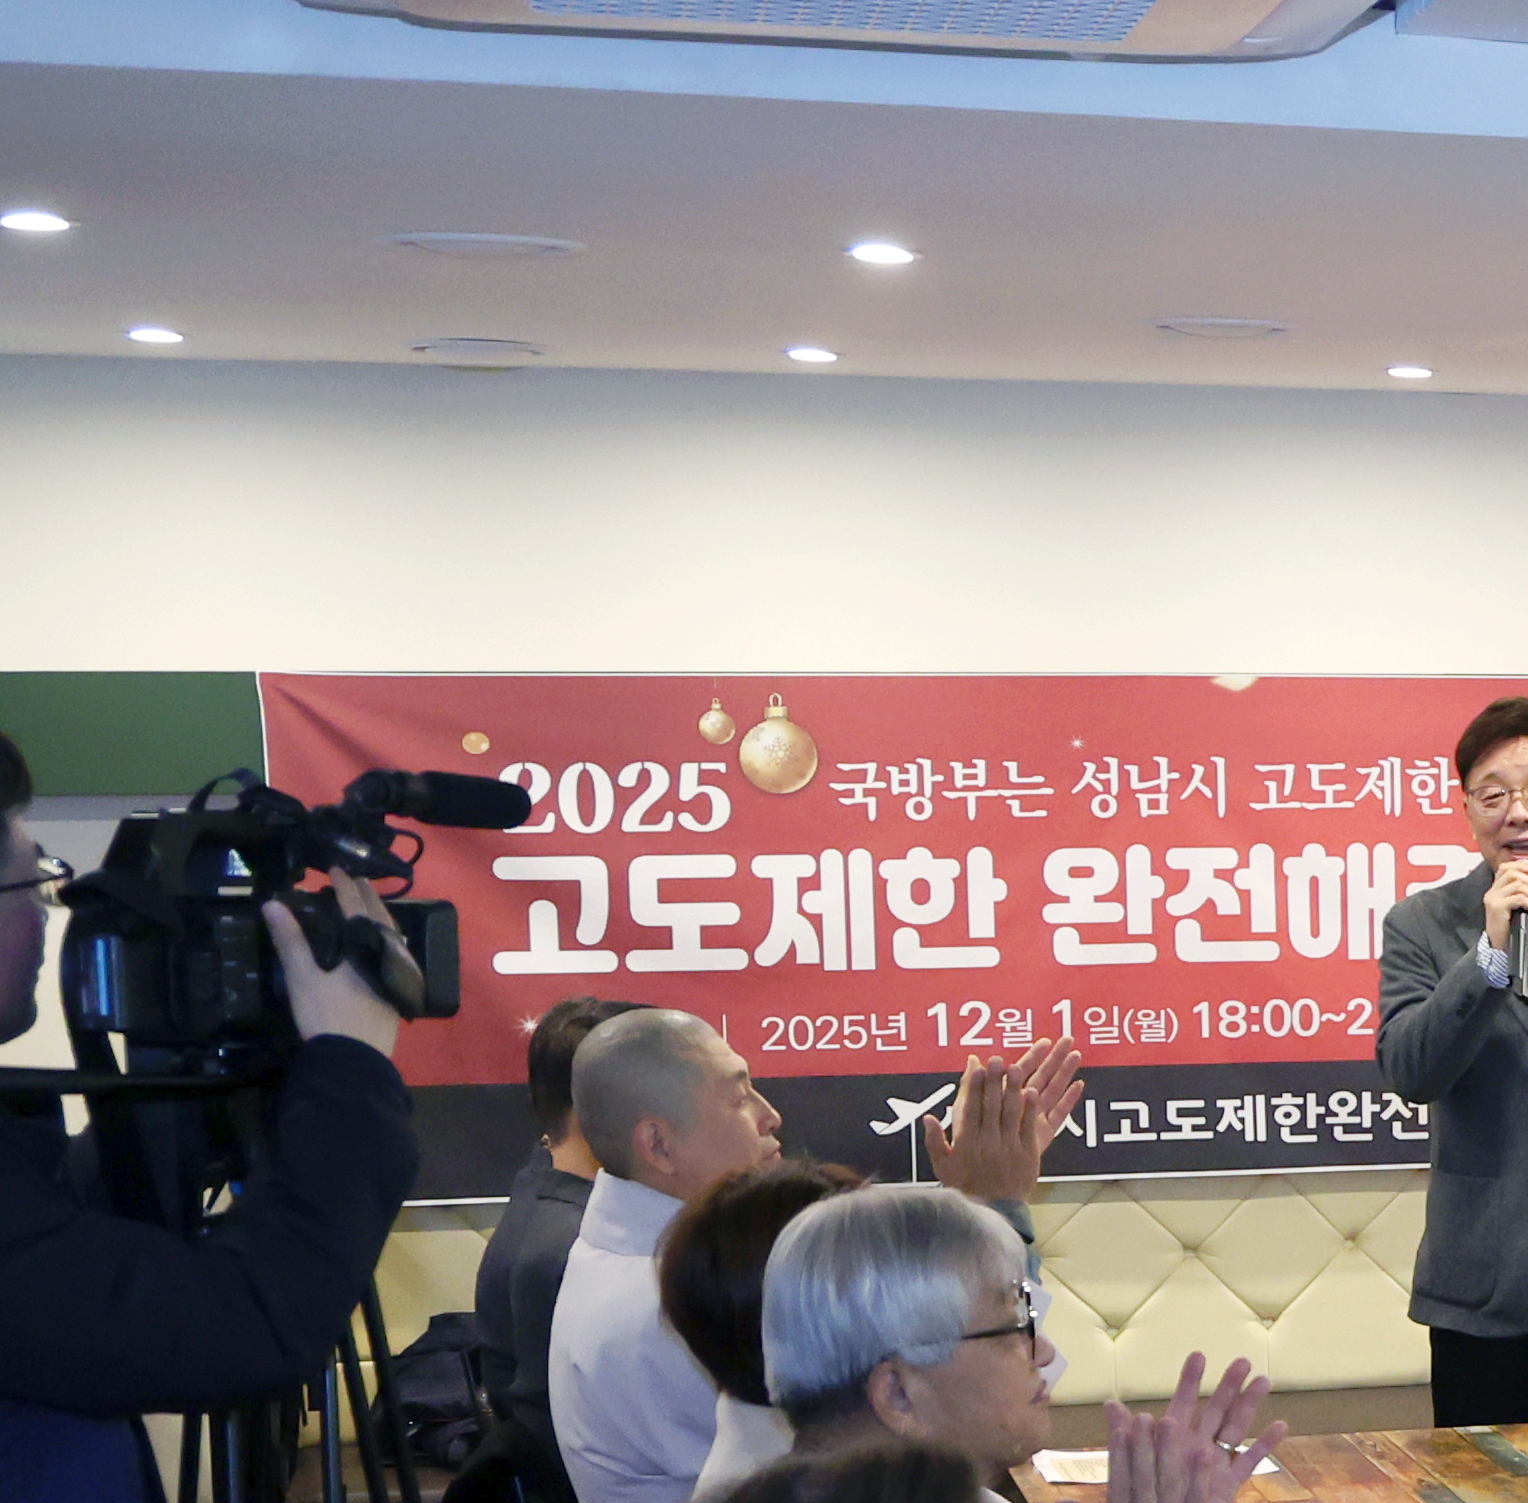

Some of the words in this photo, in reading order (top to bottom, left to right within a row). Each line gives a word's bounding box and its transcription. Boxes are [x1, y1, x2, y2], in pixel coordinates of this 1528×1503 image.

[498, 760, 732, 835] 2025
[829, 757, 1055, 822] 국방부는
[1071, 755, 1227, 819] 성남시
[1249, 755, 1460, 819] 고도제한
[492, 845, 1008, 976] 고도제한
[1042, 841, 1482, 966] 완전해
[760, 1011, 908, 1052] 2025년
[926, 999, 1034, 1048] 12월
[1051, 998, 1179, 1046] 1일(월)
